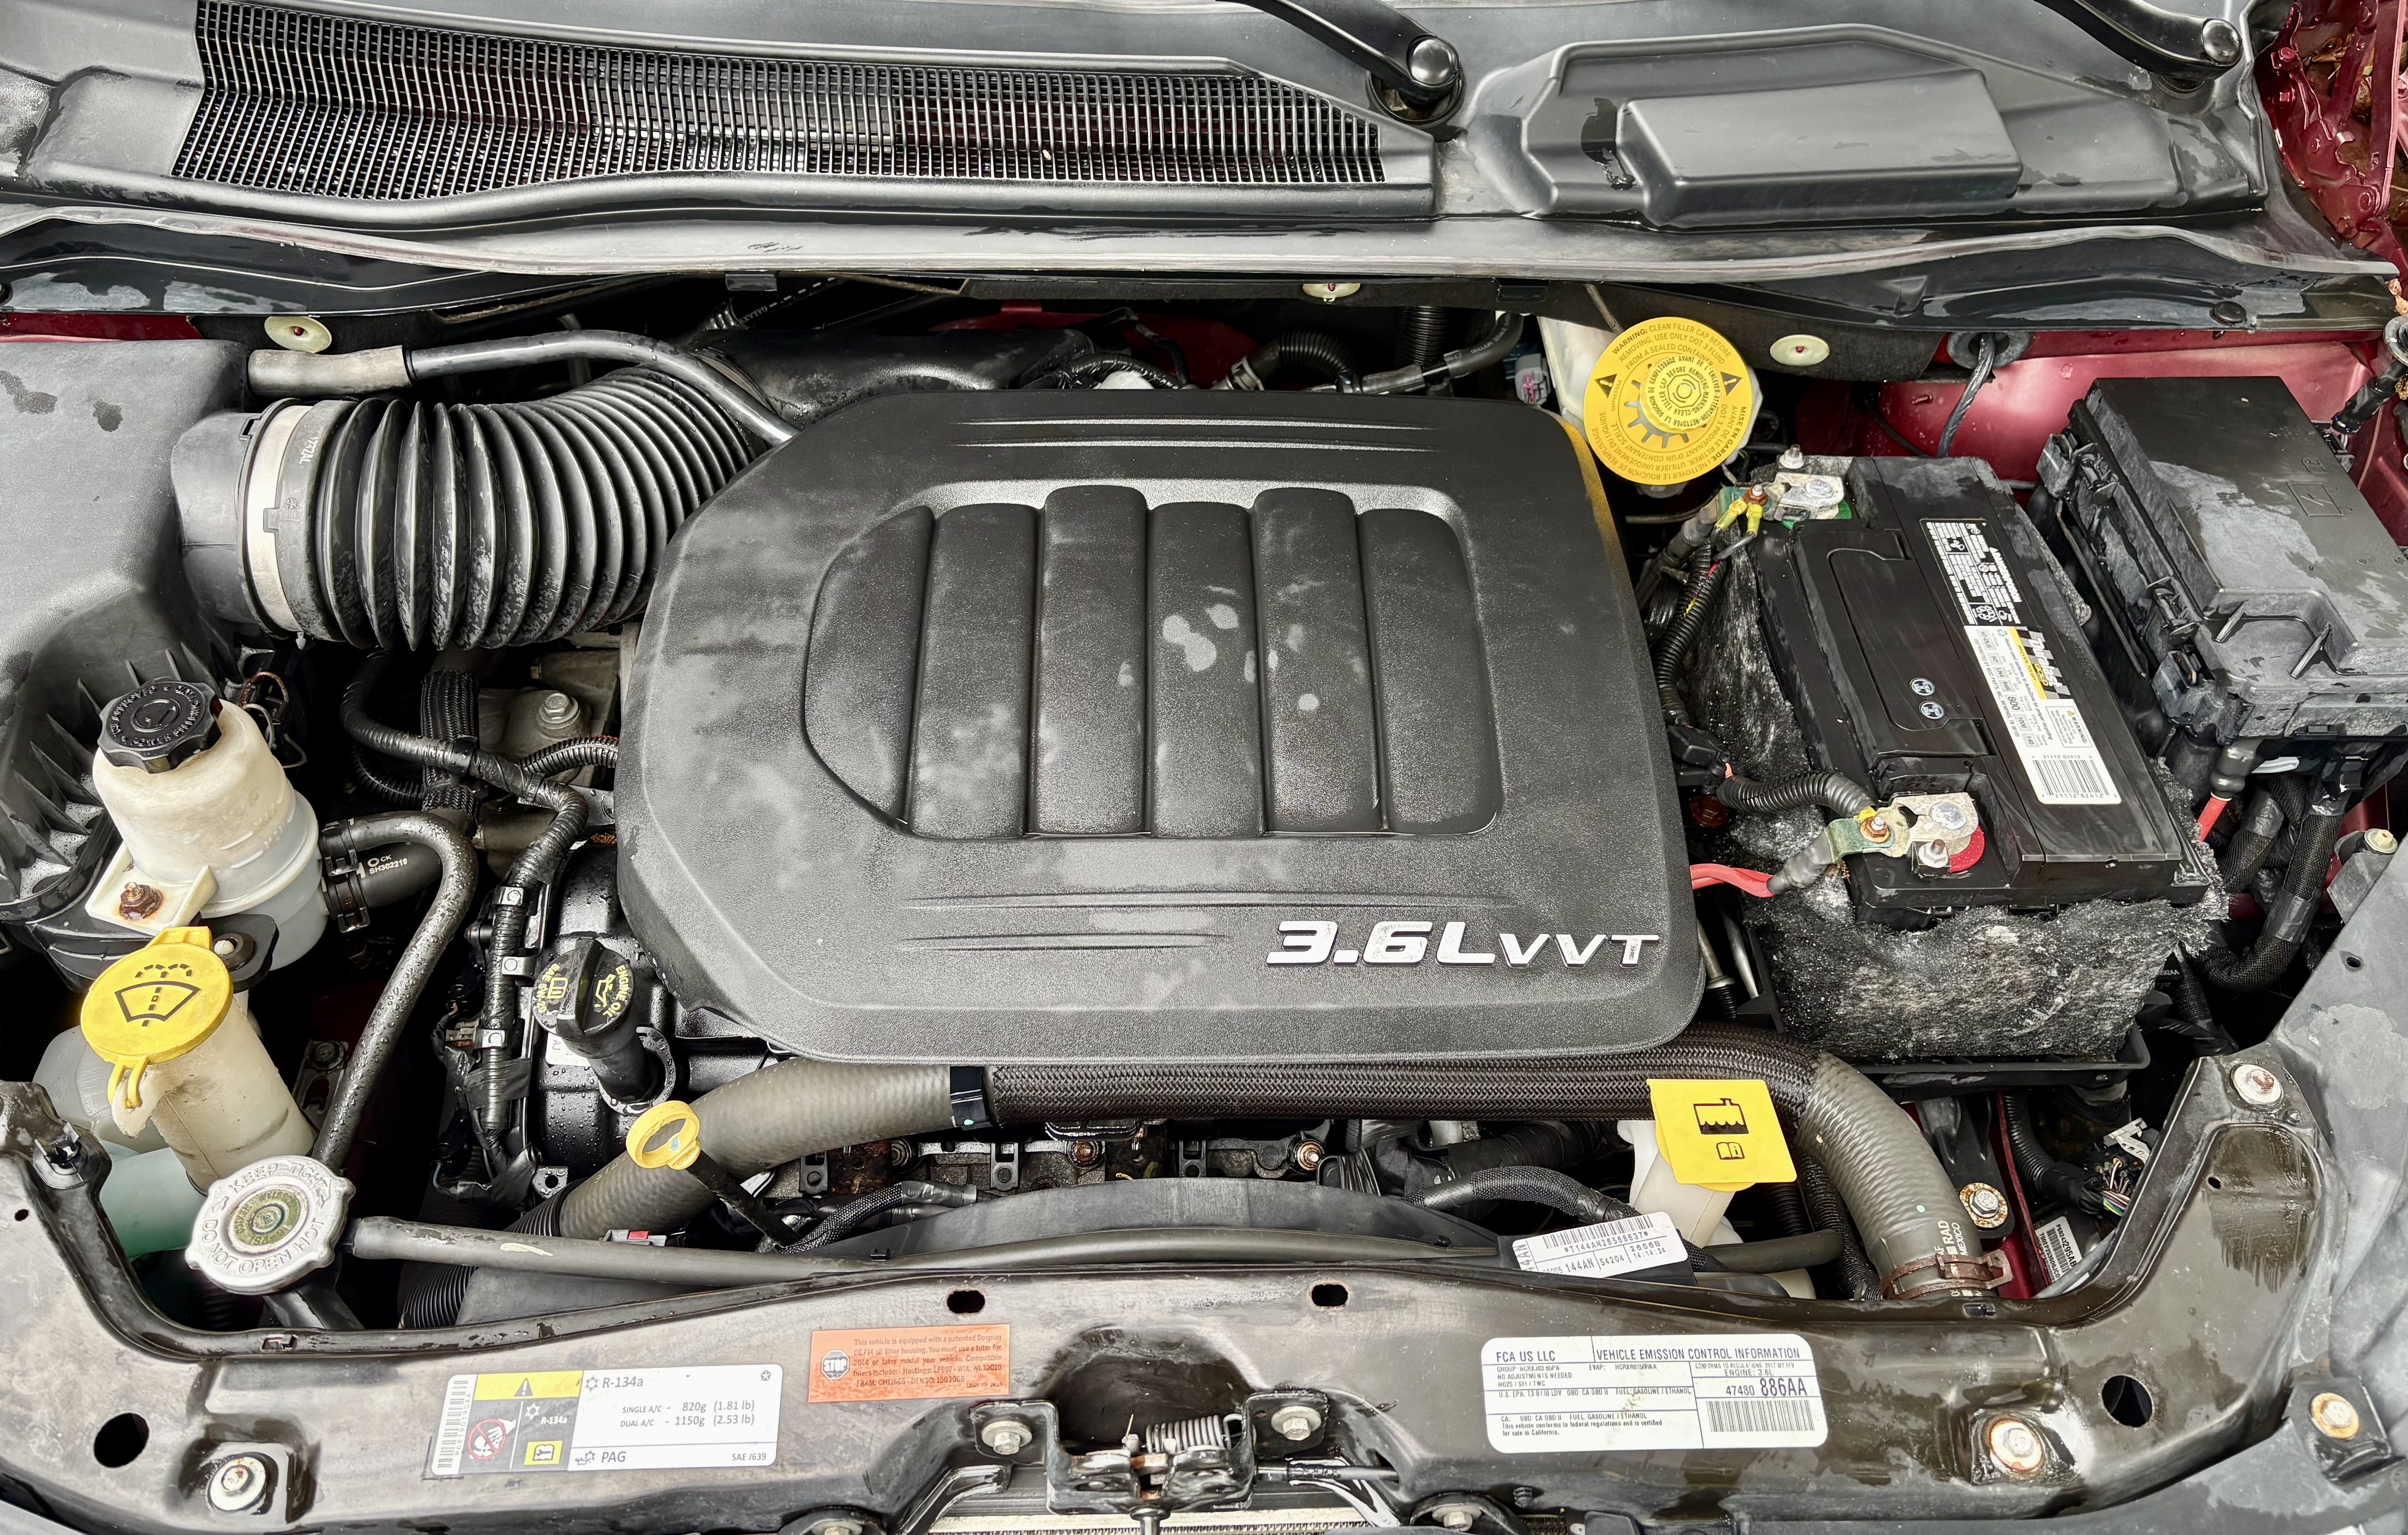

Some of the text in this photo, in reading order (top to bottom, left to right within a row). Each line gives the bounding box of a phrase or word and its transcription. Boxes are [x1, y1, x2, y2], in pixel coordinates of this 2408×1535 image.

[1612, 323, 1731, 358] WARNING: CLEAN FILLER CAP BEFORE
[1655, 333, 1668, 341] USE
[1670, 333, 1688, 341] ONLY
[1689, 336, 1703, 346] DOT
[1708, 348, 1724, 364] FLUID
[1626, 353, 1643, 370] FROM
[1651, 343, 1676, 353] SEALED
[1678, 344, 1713, 366] CONTAINER
[1649, 357, 1676, 384] REMPLISSAGE
[1666, 366, 1686, 378] BEFORE
[1649, 396, 1664, 417] BOUCHON
[1737, 407, 1746, 427] MISE
[1599, 405, 1738, 471] AVANT DE LE UTILISER UNIQUEMENT DU LIQUIDE
[1686, 425, 1720, 456] PROVENANT
[1732, 428, 1740, 438] EN
[1592, 427, 1619, 466] REMPLISSAGE
[1625, 444, 1664, 462] CONTENANT
[1713, 439, 1733, 462] GARDE
[1628, 468, 1660, 480] BOUCHON
[1673, 464, 1707, 479] NETTOYER
[2028, 638, 2063, 688] Duralast
[2034, 663, 2049, 686] GOLD
[1980, 631, 1992, 649] H7-DLG
[2002, 681, 2010, 691] 94R
[2008, 696, 2020, 711] 800
[2017, 717, 2027, 728] 1000
[2026, 736, 2035, 745] 140
[369, 858, 408, 874] SH302219
[1265, 920, 1660, 969] 3.6L VVT
[536, 963, 560, 1013] SAE 5W-20
[603, 965, 630, 1017] ENGINE OIL
[228, 1162, 328, 1193] KEEP TIGHT
[203, 1219, 219, 1243] DO
[294, 1218, 324, 1251] HOT
[1943, 1220, 1954, 1245] RAD
[1952, 1222, 1967, 1256] MEXICO
[208, 1243, 238, 1269] NOT
[1630, 1241, 1660, 1252] 2656B
[1633, 1247, 1666, 1259] 14:14:34
[239, 1249, 292, 1274] OPEN
[1566, 1254, 1624, 1273] 144AN S4204
[898, 1336, 927, 1345] equipped
[948, 1335, 976, 1343] patented
[966, 1354, 1001, 1362] Compatible
[1496, 1351, 1555, 1362] FCA US LLC
[1597, 1348, 1800, 1360] VEHICLE EMISSION CONTROL INFORMATION
[824, 1359, 846, 1371] STOP
[602, 1376, 643, 1388] R-134a
[1726, 1378, 1807, 1396] 47480 886AA
[649, 1405, 662, 1413] A/C
[683, 1402, 706, 1413] 820g
[714, 1401, 739, 1413] (1.81
[742, 1400, 755, 1411] lb)
[541, 1416, 568, 1424] R-134a
[641, 1419, 654, 1427] A/C
[675, 1416, 705, 1427] 1150g
[713, 1415, 739, 1427] (2.53
[742, 1413, 755, 1426] lb)
[602, 1452, 626, 1463] PAG
